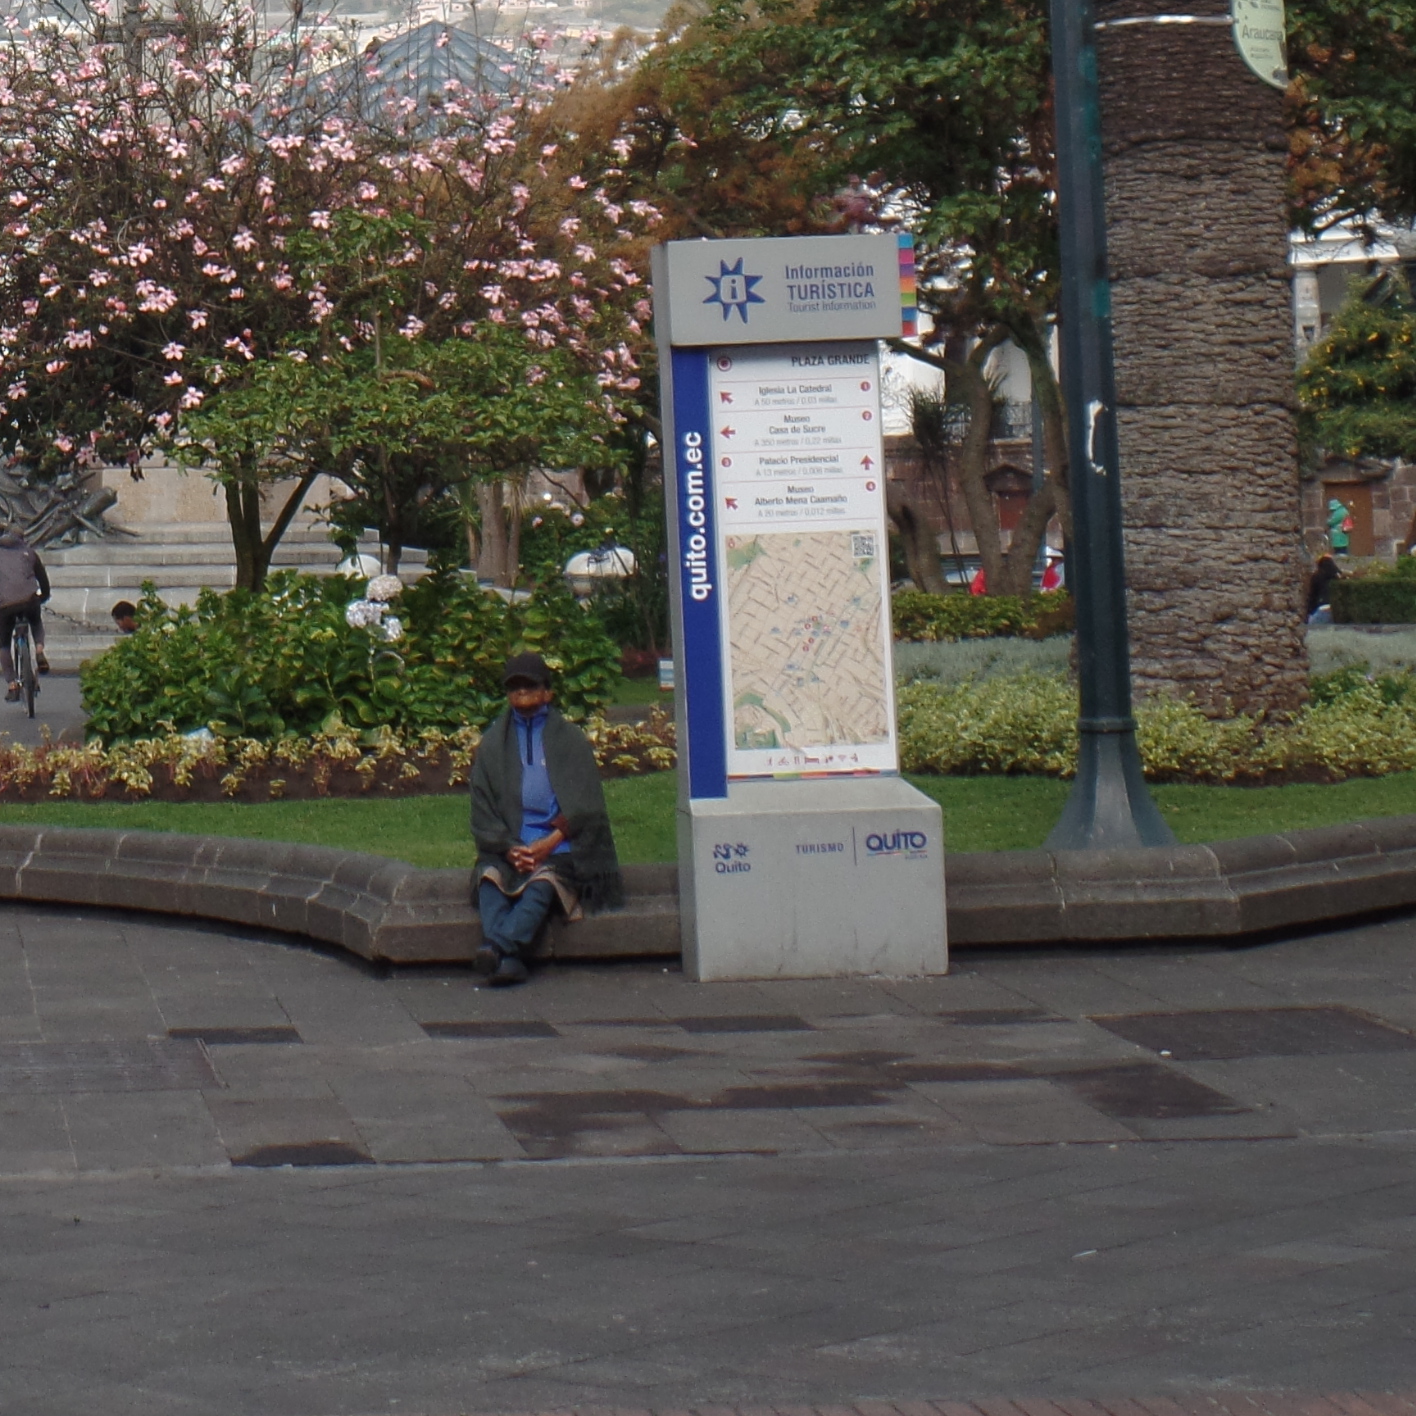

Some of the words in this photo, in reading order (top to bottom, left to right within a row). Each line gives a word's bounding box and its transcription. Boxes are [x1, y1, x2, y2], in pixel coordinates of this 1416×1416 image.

[785, 262, 874, 279] Información
[787, 279, 875, 301] TURÍSTICA
[787, 301, 820, 313] Tourist
[822, 300, 877, 312] Information
[791, 355, 825, 367] PLAZA
[827, 354, 870, 366] GRANDE
[758, 385, 785, 396] Iglesia
[787, 385, 797, 394] La
[799, 384, 832, 394] Catedral
[784, 415, 810, 424] Museo
[769, 425, 789, 434] Casa
[791, 425, 801, 433] de
[803, 424, 826, 433] Sucre
[759, 456, 789, 465] Palacio
[790, 454, 839, 464] Presidencial
[787, 485, 814, 494] Museo
[754, 496, 784, 506] Alberto
[785, 495, 808, 504] Mena
[810, 494, 848, 504] Caamaño
[685, 432, 713, 601] quito.com.ec
[865, 829, 927, 851] QUITO
[795, 843, 844, 854] TURISMO
[715, 861, 751, 874] Quito
